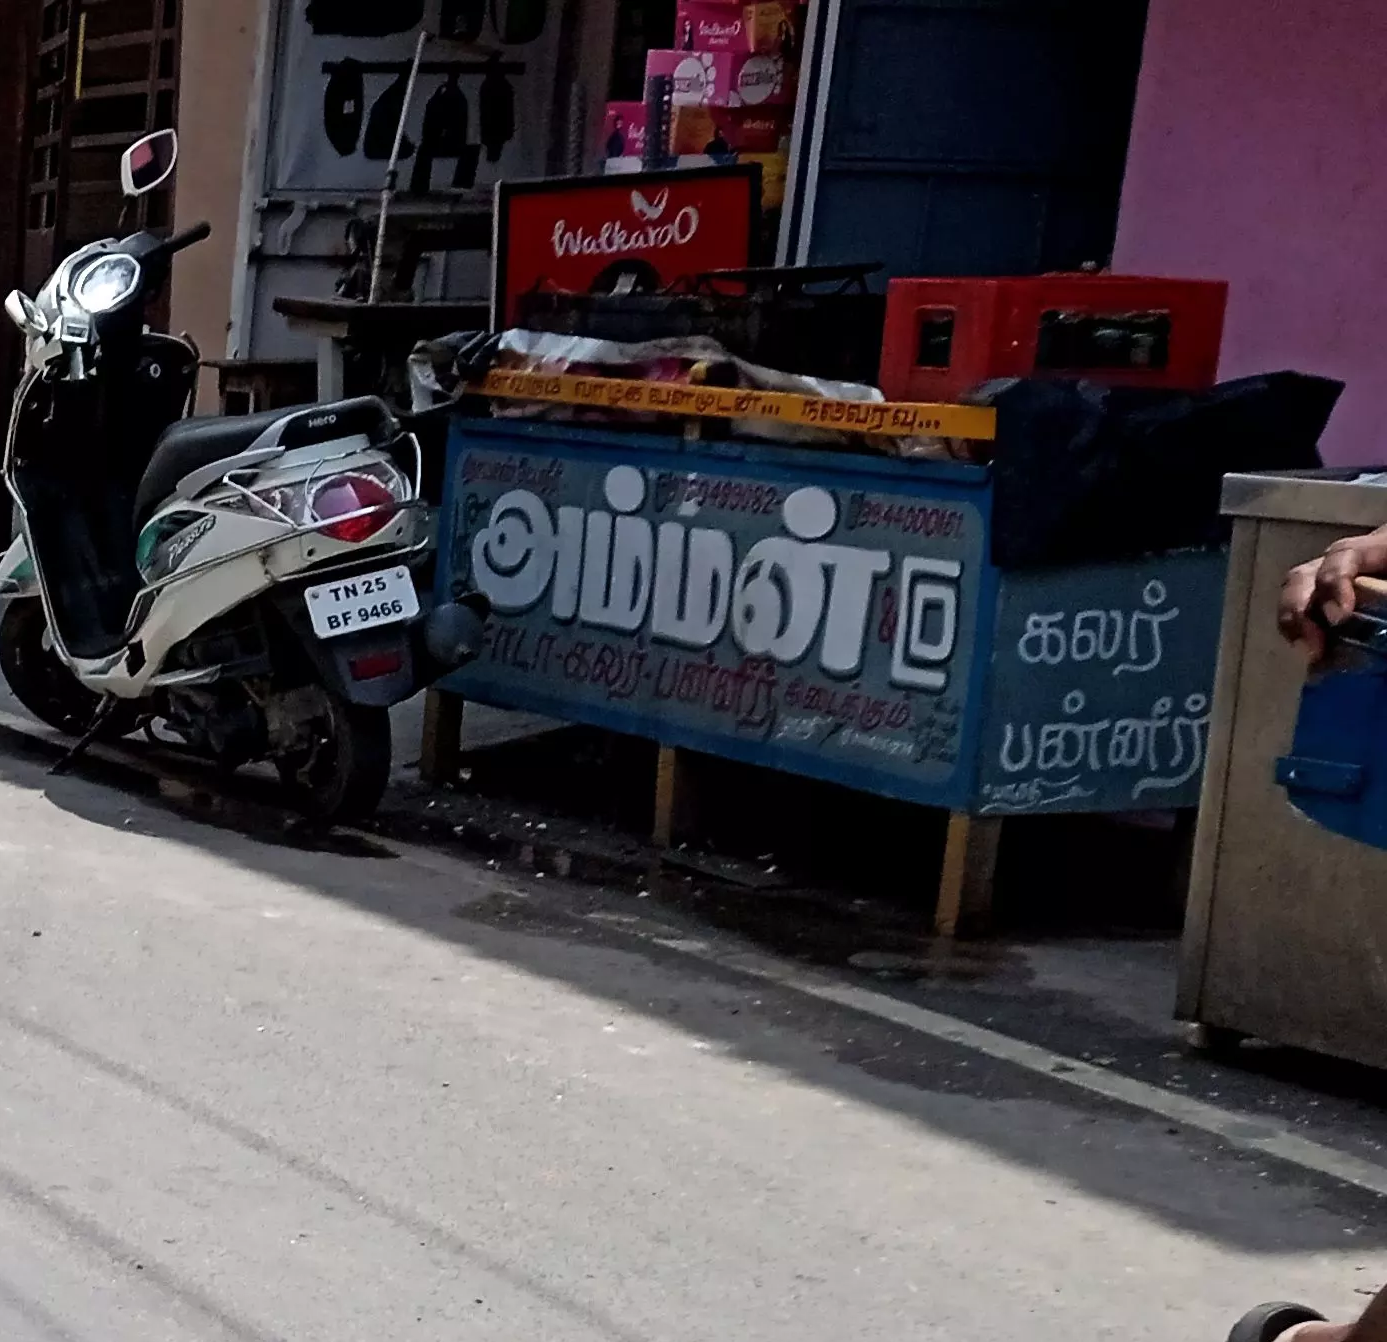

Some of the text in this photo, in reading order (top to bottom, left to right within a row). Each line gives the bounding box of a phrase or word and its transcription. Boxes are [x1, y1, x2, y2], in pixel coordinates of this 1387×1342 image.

[308, 413, 337, 428] Hero
[330, 576, 387, 602] TN 25
[471, 464, 893, 679] அம்மன்
[326, 599, 403, 630] BF 9466
[1017, 579, 1179, 676] கலர்
[999, 688, 1212, 800] பன்னீர்
